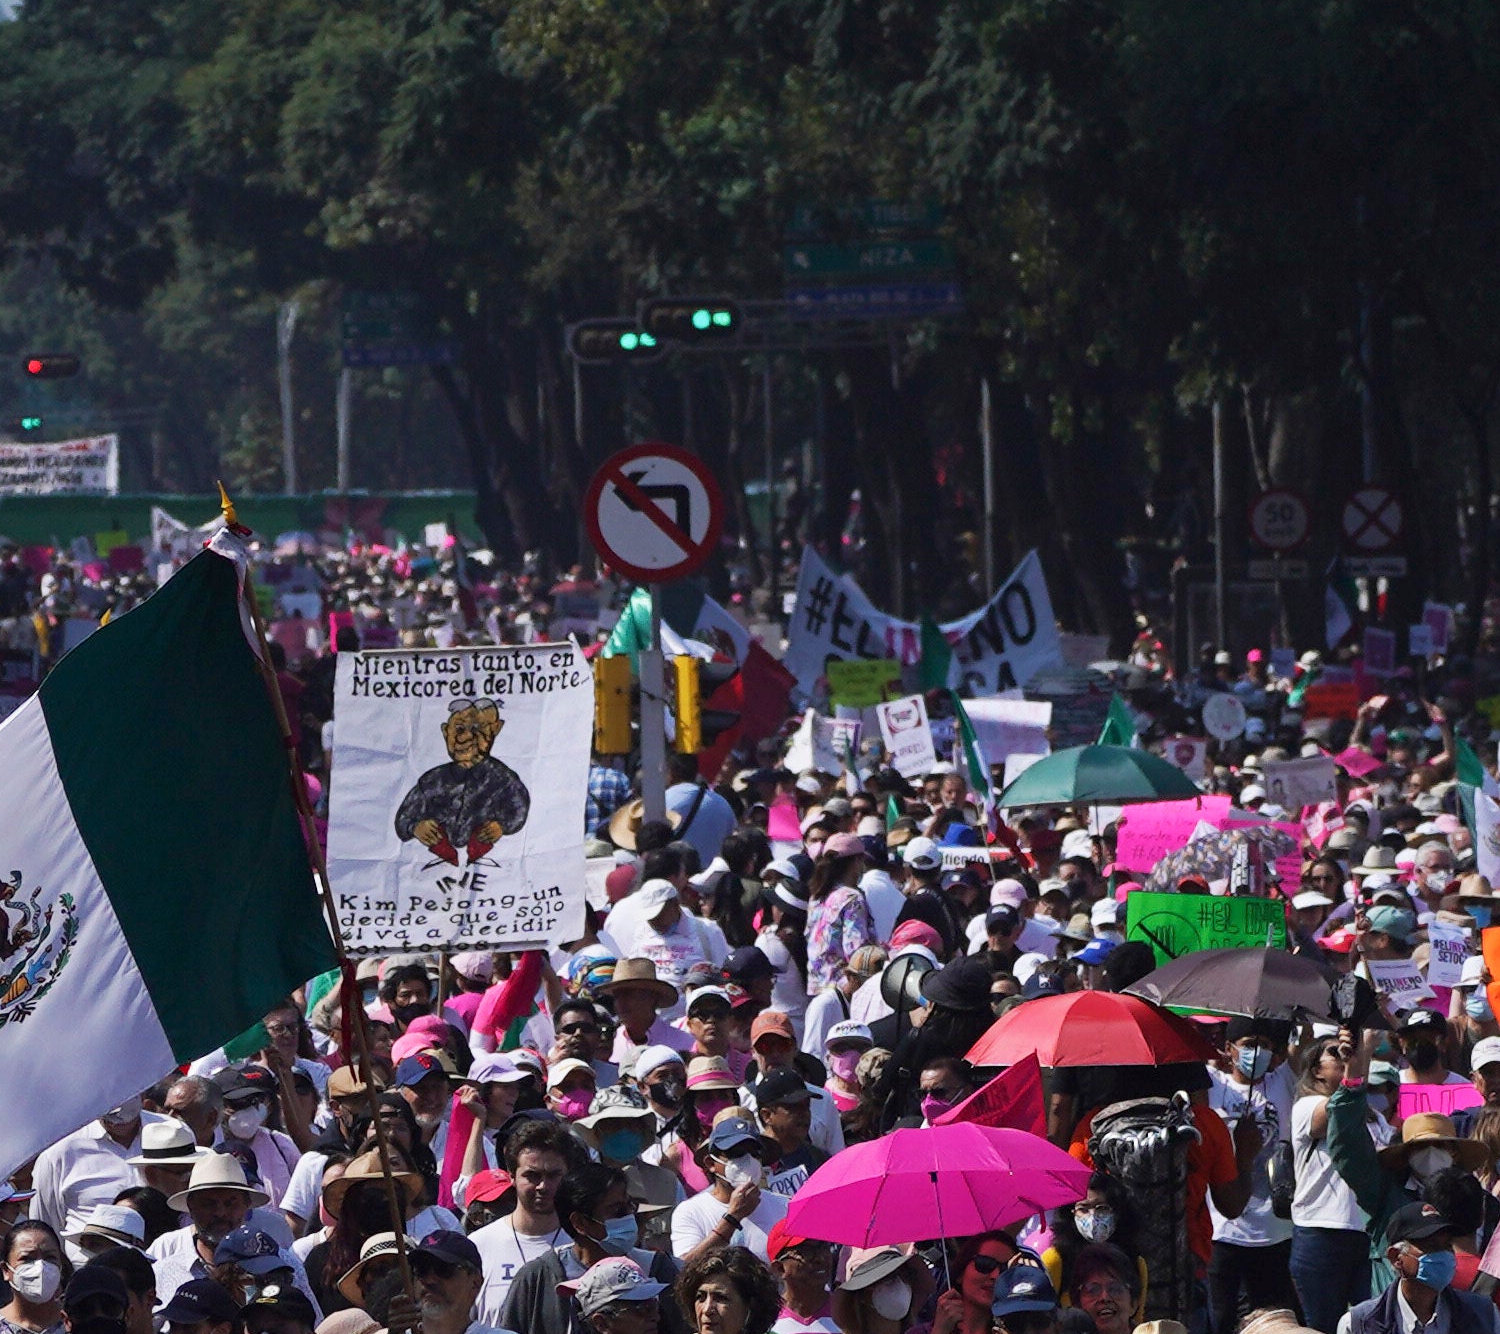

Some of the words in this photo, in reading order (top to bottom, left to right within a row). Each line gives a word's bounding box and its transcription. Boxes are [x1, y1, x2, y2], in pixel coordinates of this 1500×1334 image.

[1264, 503, 1293, 521] 50
[352, 655, 461, 676] Mientras
[472, 653, 543, 671] tanto,
[549, 651, 574, 667] en
[350, 675, 477, 699] Mexicorea
[483, 673, 514, 695] del
[436, 871, 488, 894] INE
[339, 895, 398, 910] Kim
[409, 886, 562, 914] Pejong-un
[340, 914, 428, 928] decide
[449, 911, 499, 930] que
[515, 901, 564, 918] sólo
[376, 927, 409, 940] va
[426, 928, 442, 940] a
[460, 917, 557, 937] decidir
